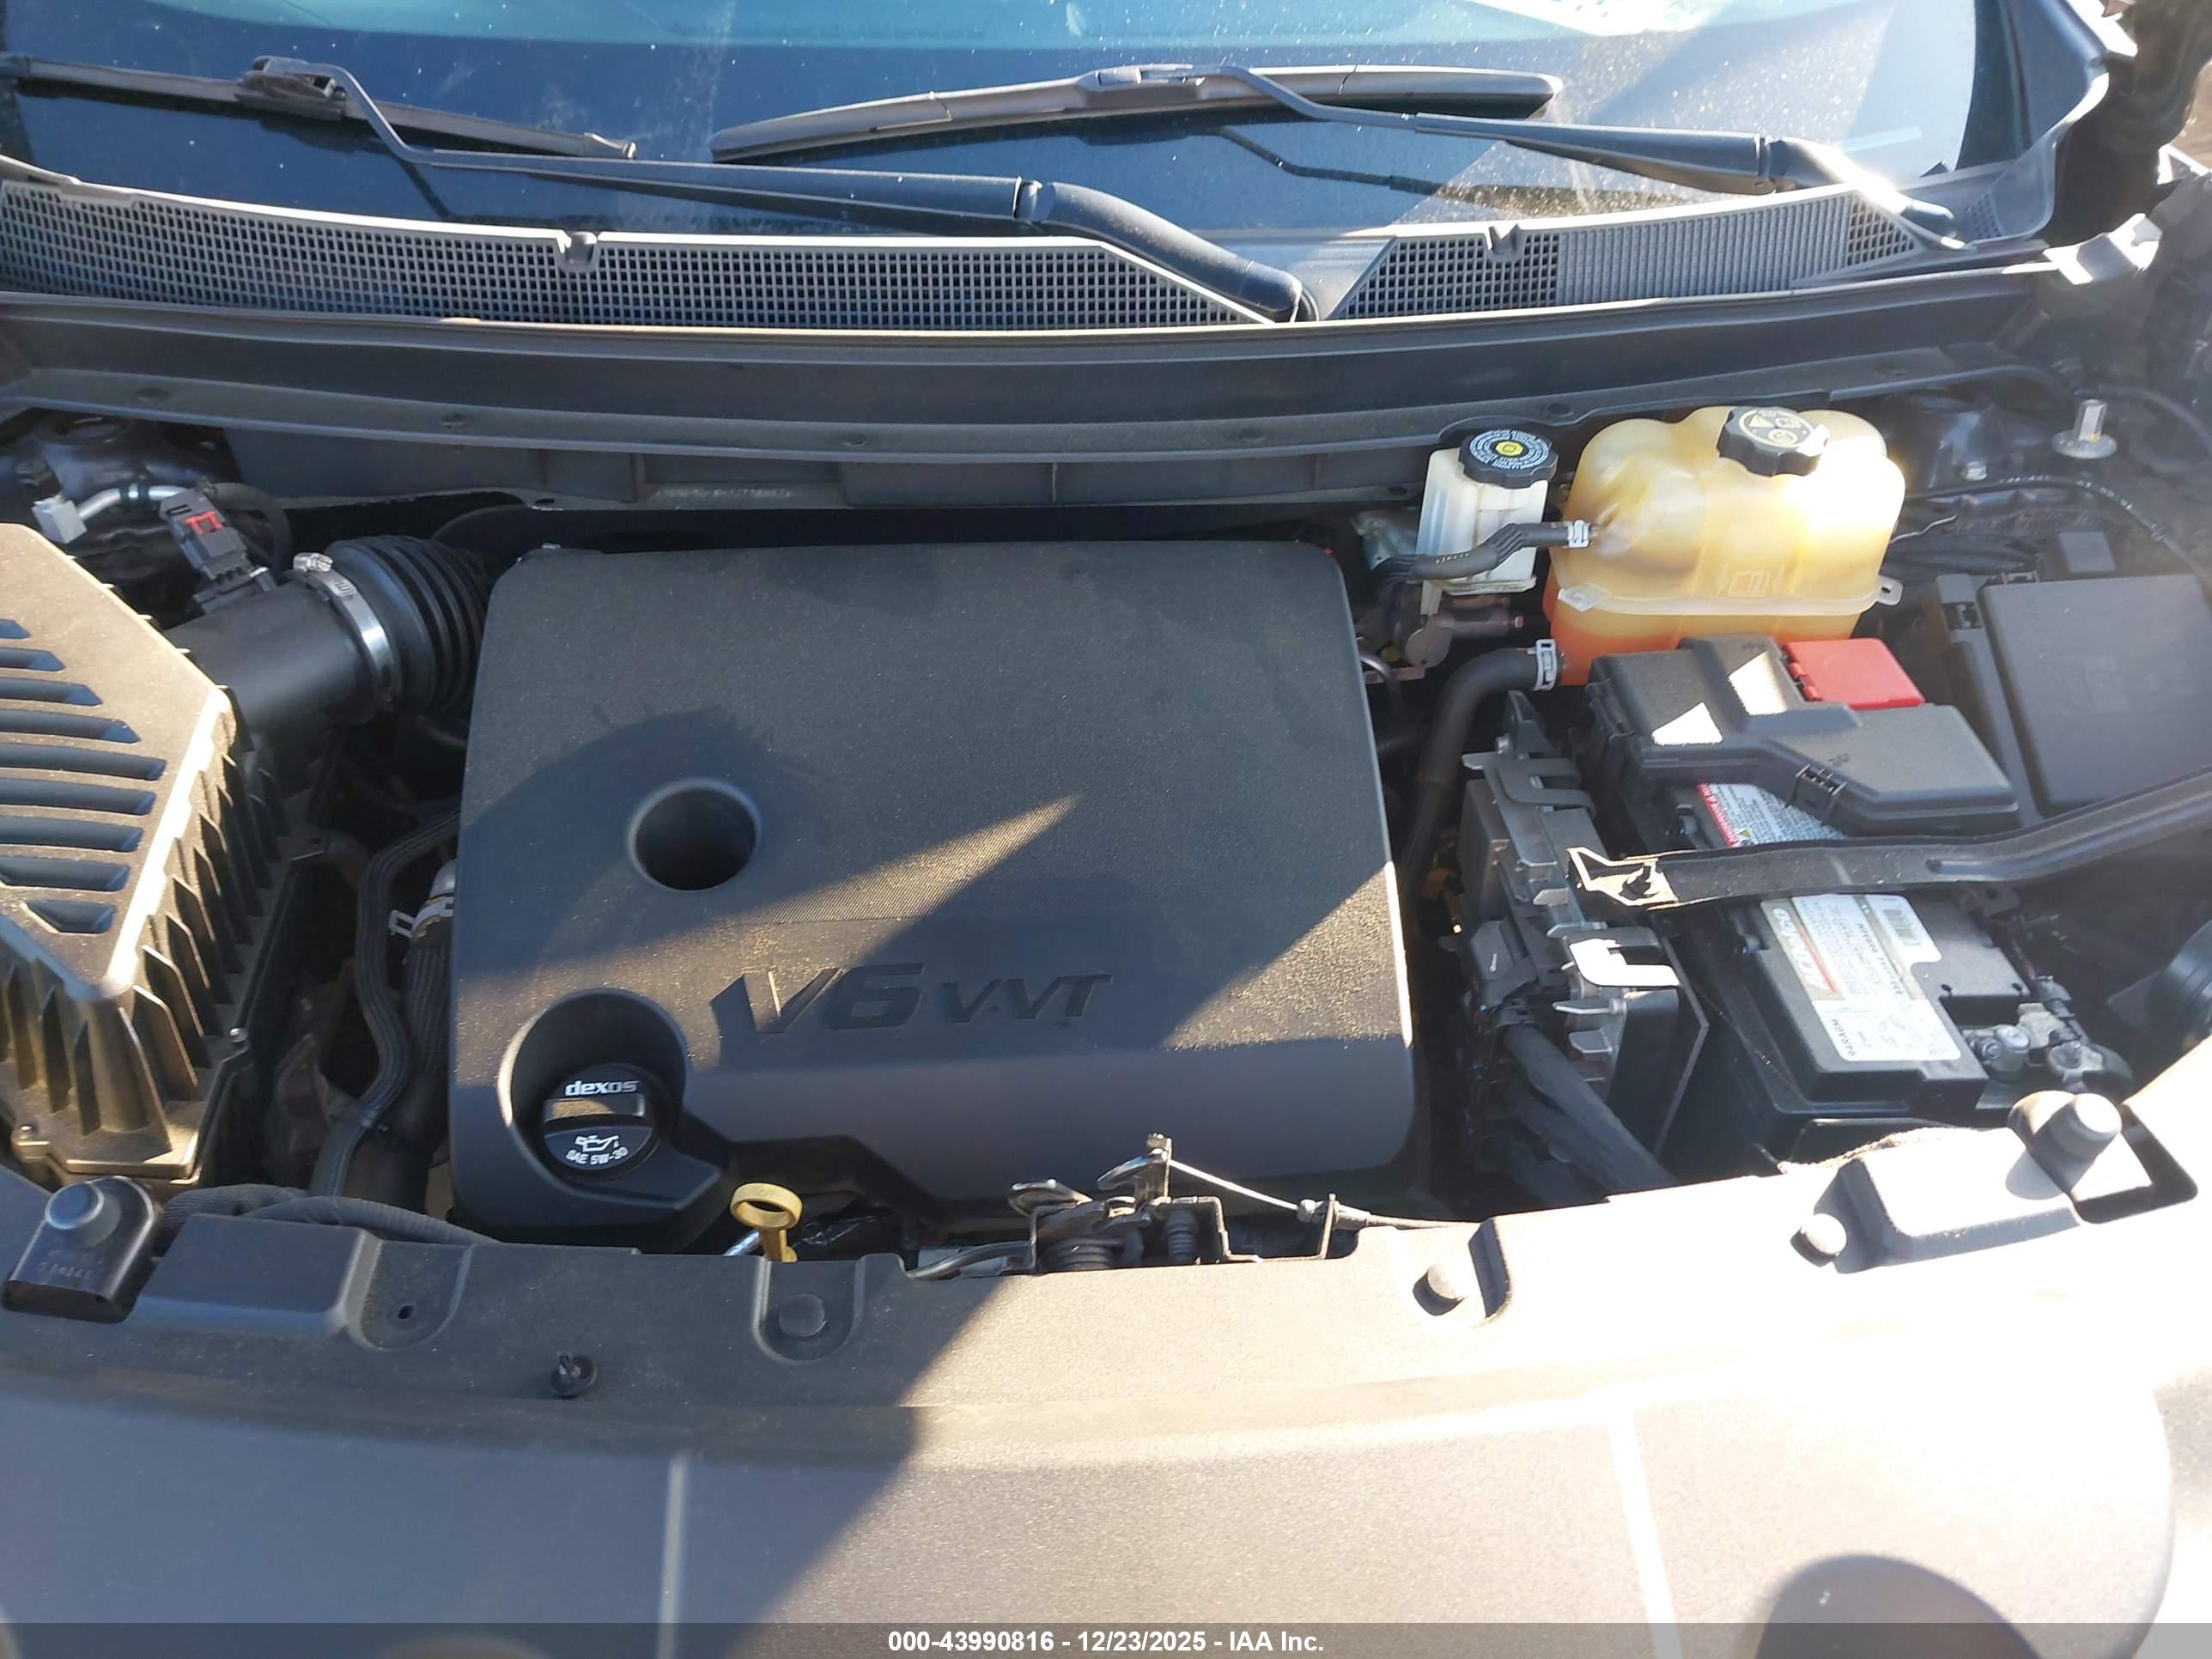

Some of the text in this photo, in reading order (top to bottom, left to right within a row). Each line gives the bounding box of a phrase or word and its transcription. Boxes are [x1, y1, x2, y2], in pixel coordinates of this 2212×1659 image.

[740, 963, 1114, 1034] V6 VVT
[565, 1080, 640, 1097] dexos
[566, 1146, 629, 1165] SAE 5W-30
